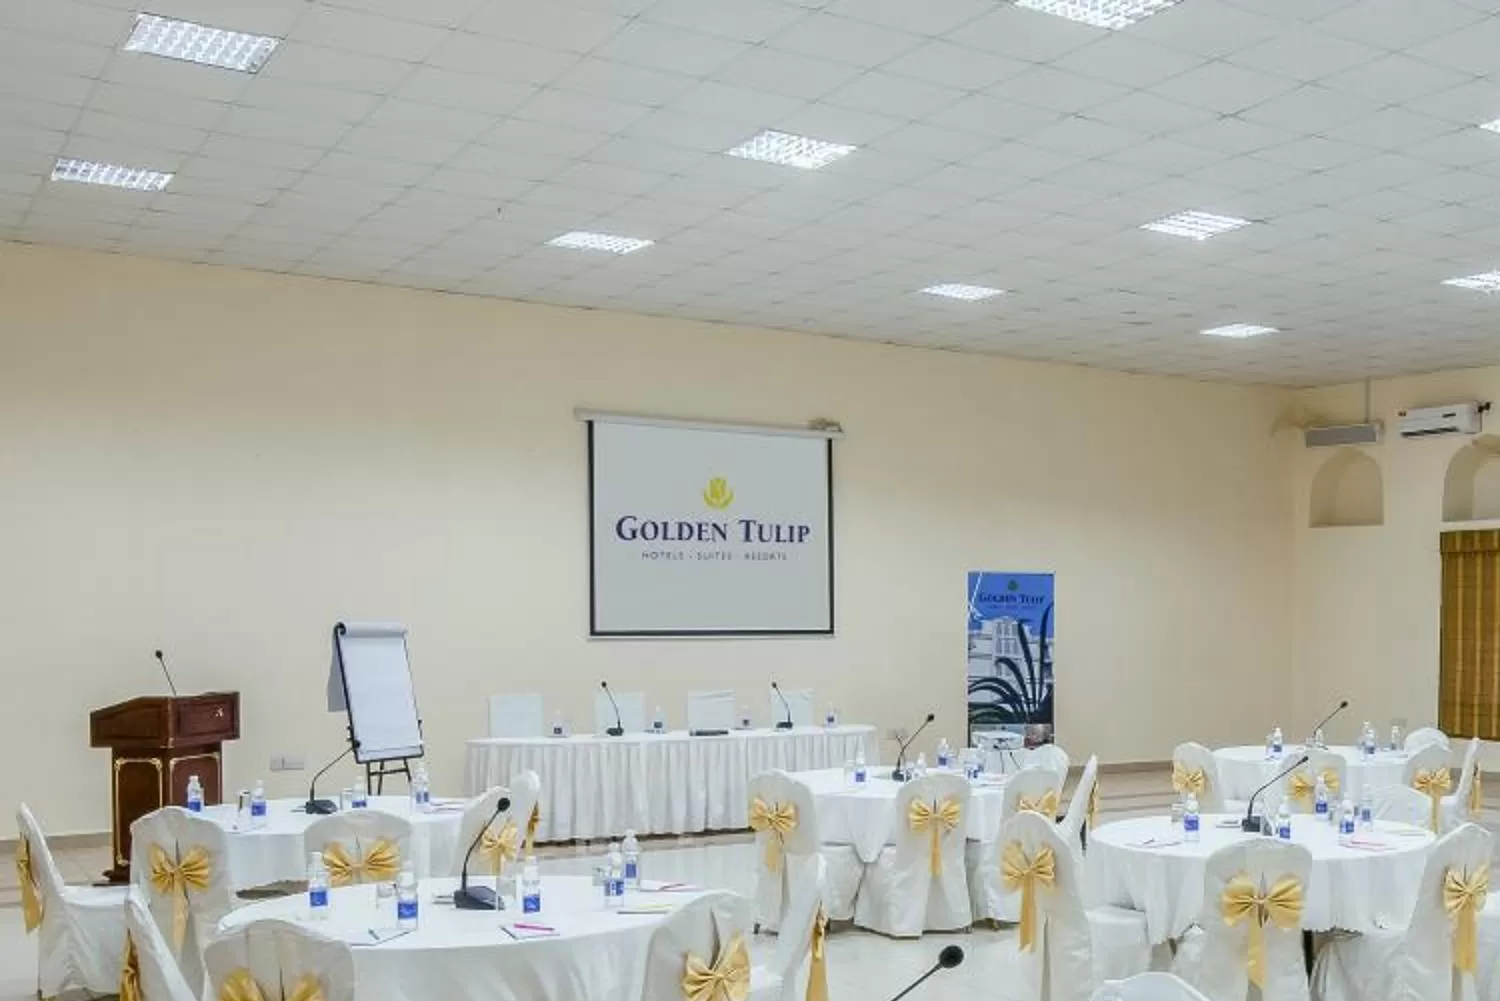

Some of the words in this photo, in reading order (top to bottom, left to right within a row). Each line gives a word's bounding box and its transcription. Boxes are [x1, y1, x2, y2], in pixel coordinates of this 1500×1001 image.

[616, 515, 728, 542] GOLDEN
[738, 519, 811, 543] TULIP
[641, 551, 684, 561] HOTELS
